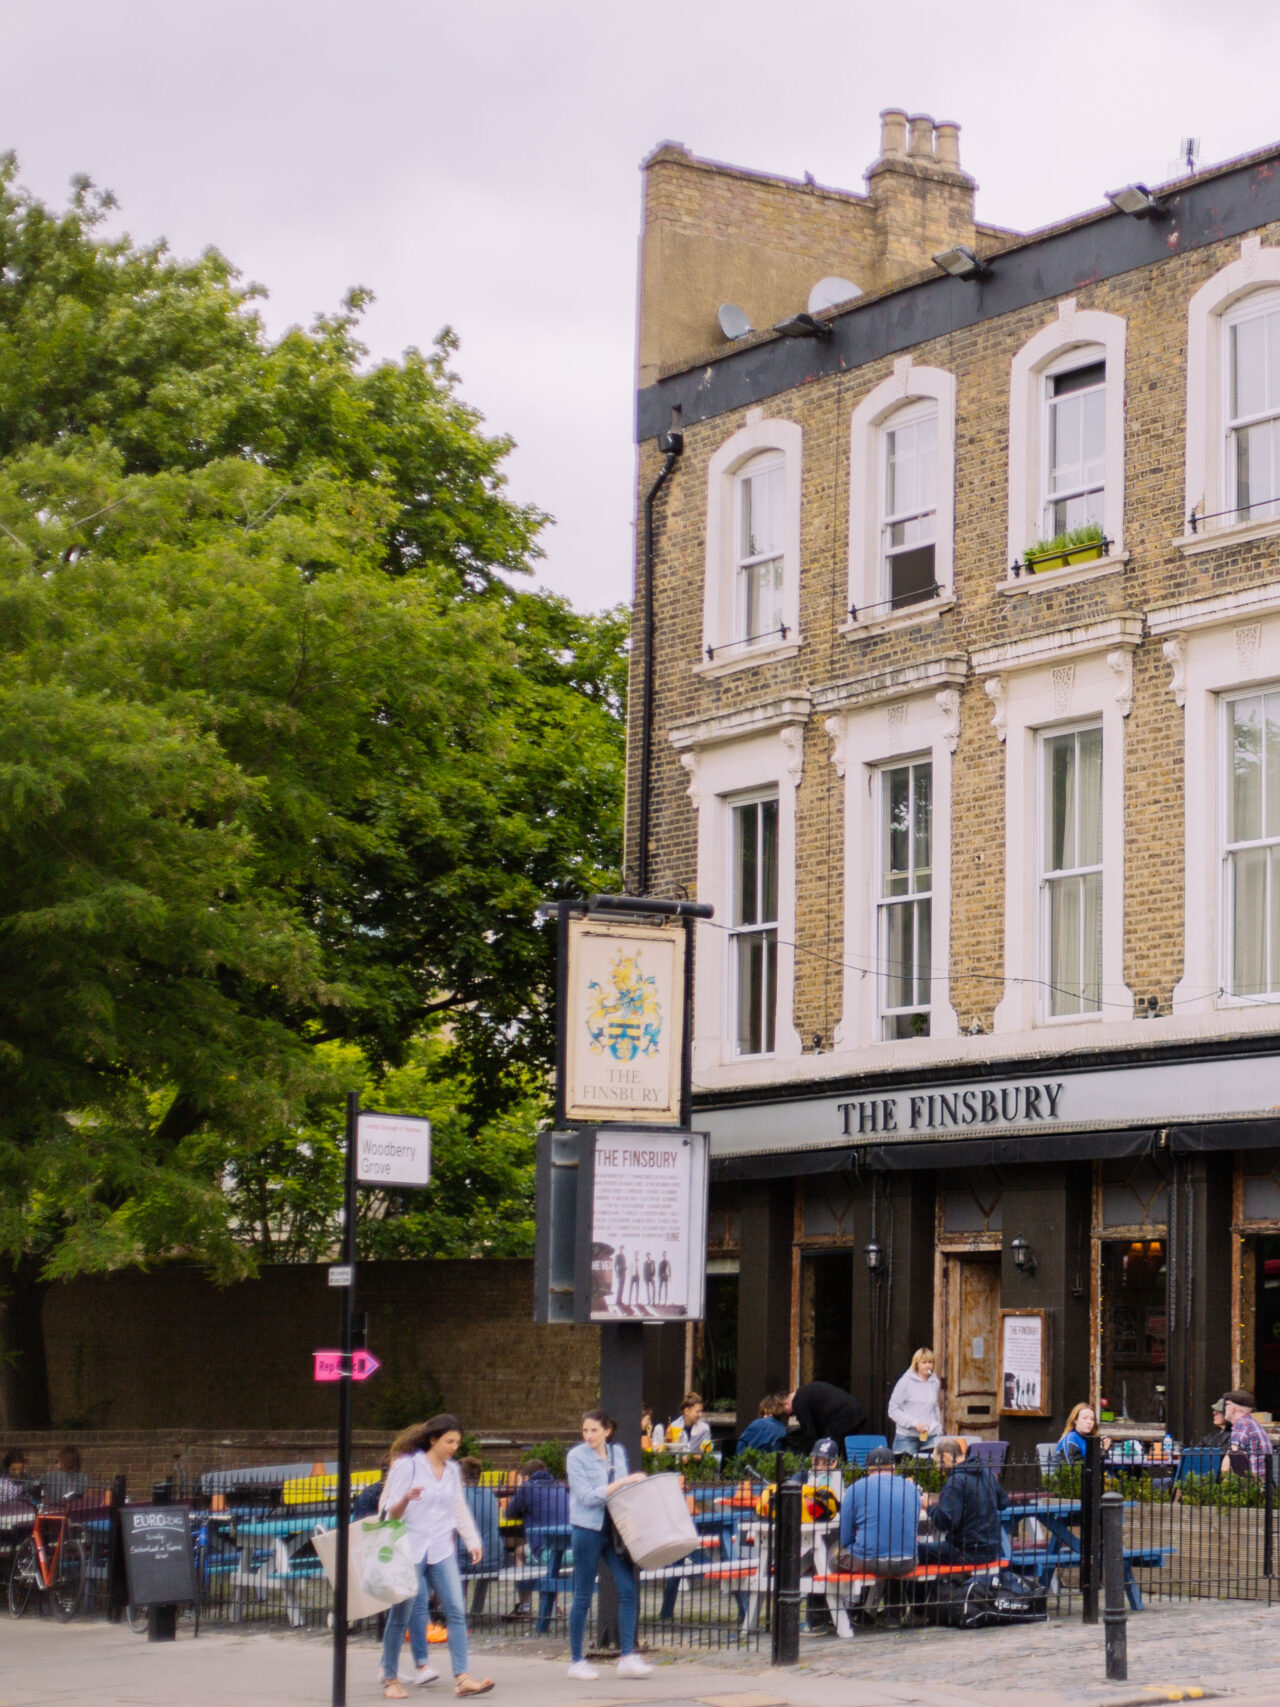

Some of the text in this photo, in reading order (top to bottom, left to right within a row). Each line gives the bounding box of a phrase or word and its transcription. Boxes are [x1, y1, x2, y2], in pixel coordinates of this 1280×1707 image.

[606, 1069, 641, 1084] THE
[583, 1085, 662, 1102] FINSBURY
[837, 1083, 1064, 1135] THE FINSBURY
[362, 1139, 416, 1162] Woodberry
[596, 1149, 678, 1169] THE FINSBURY
[361, 1157, 391, 1175] Grove
[133, 1514, 166, 1528] EURO
